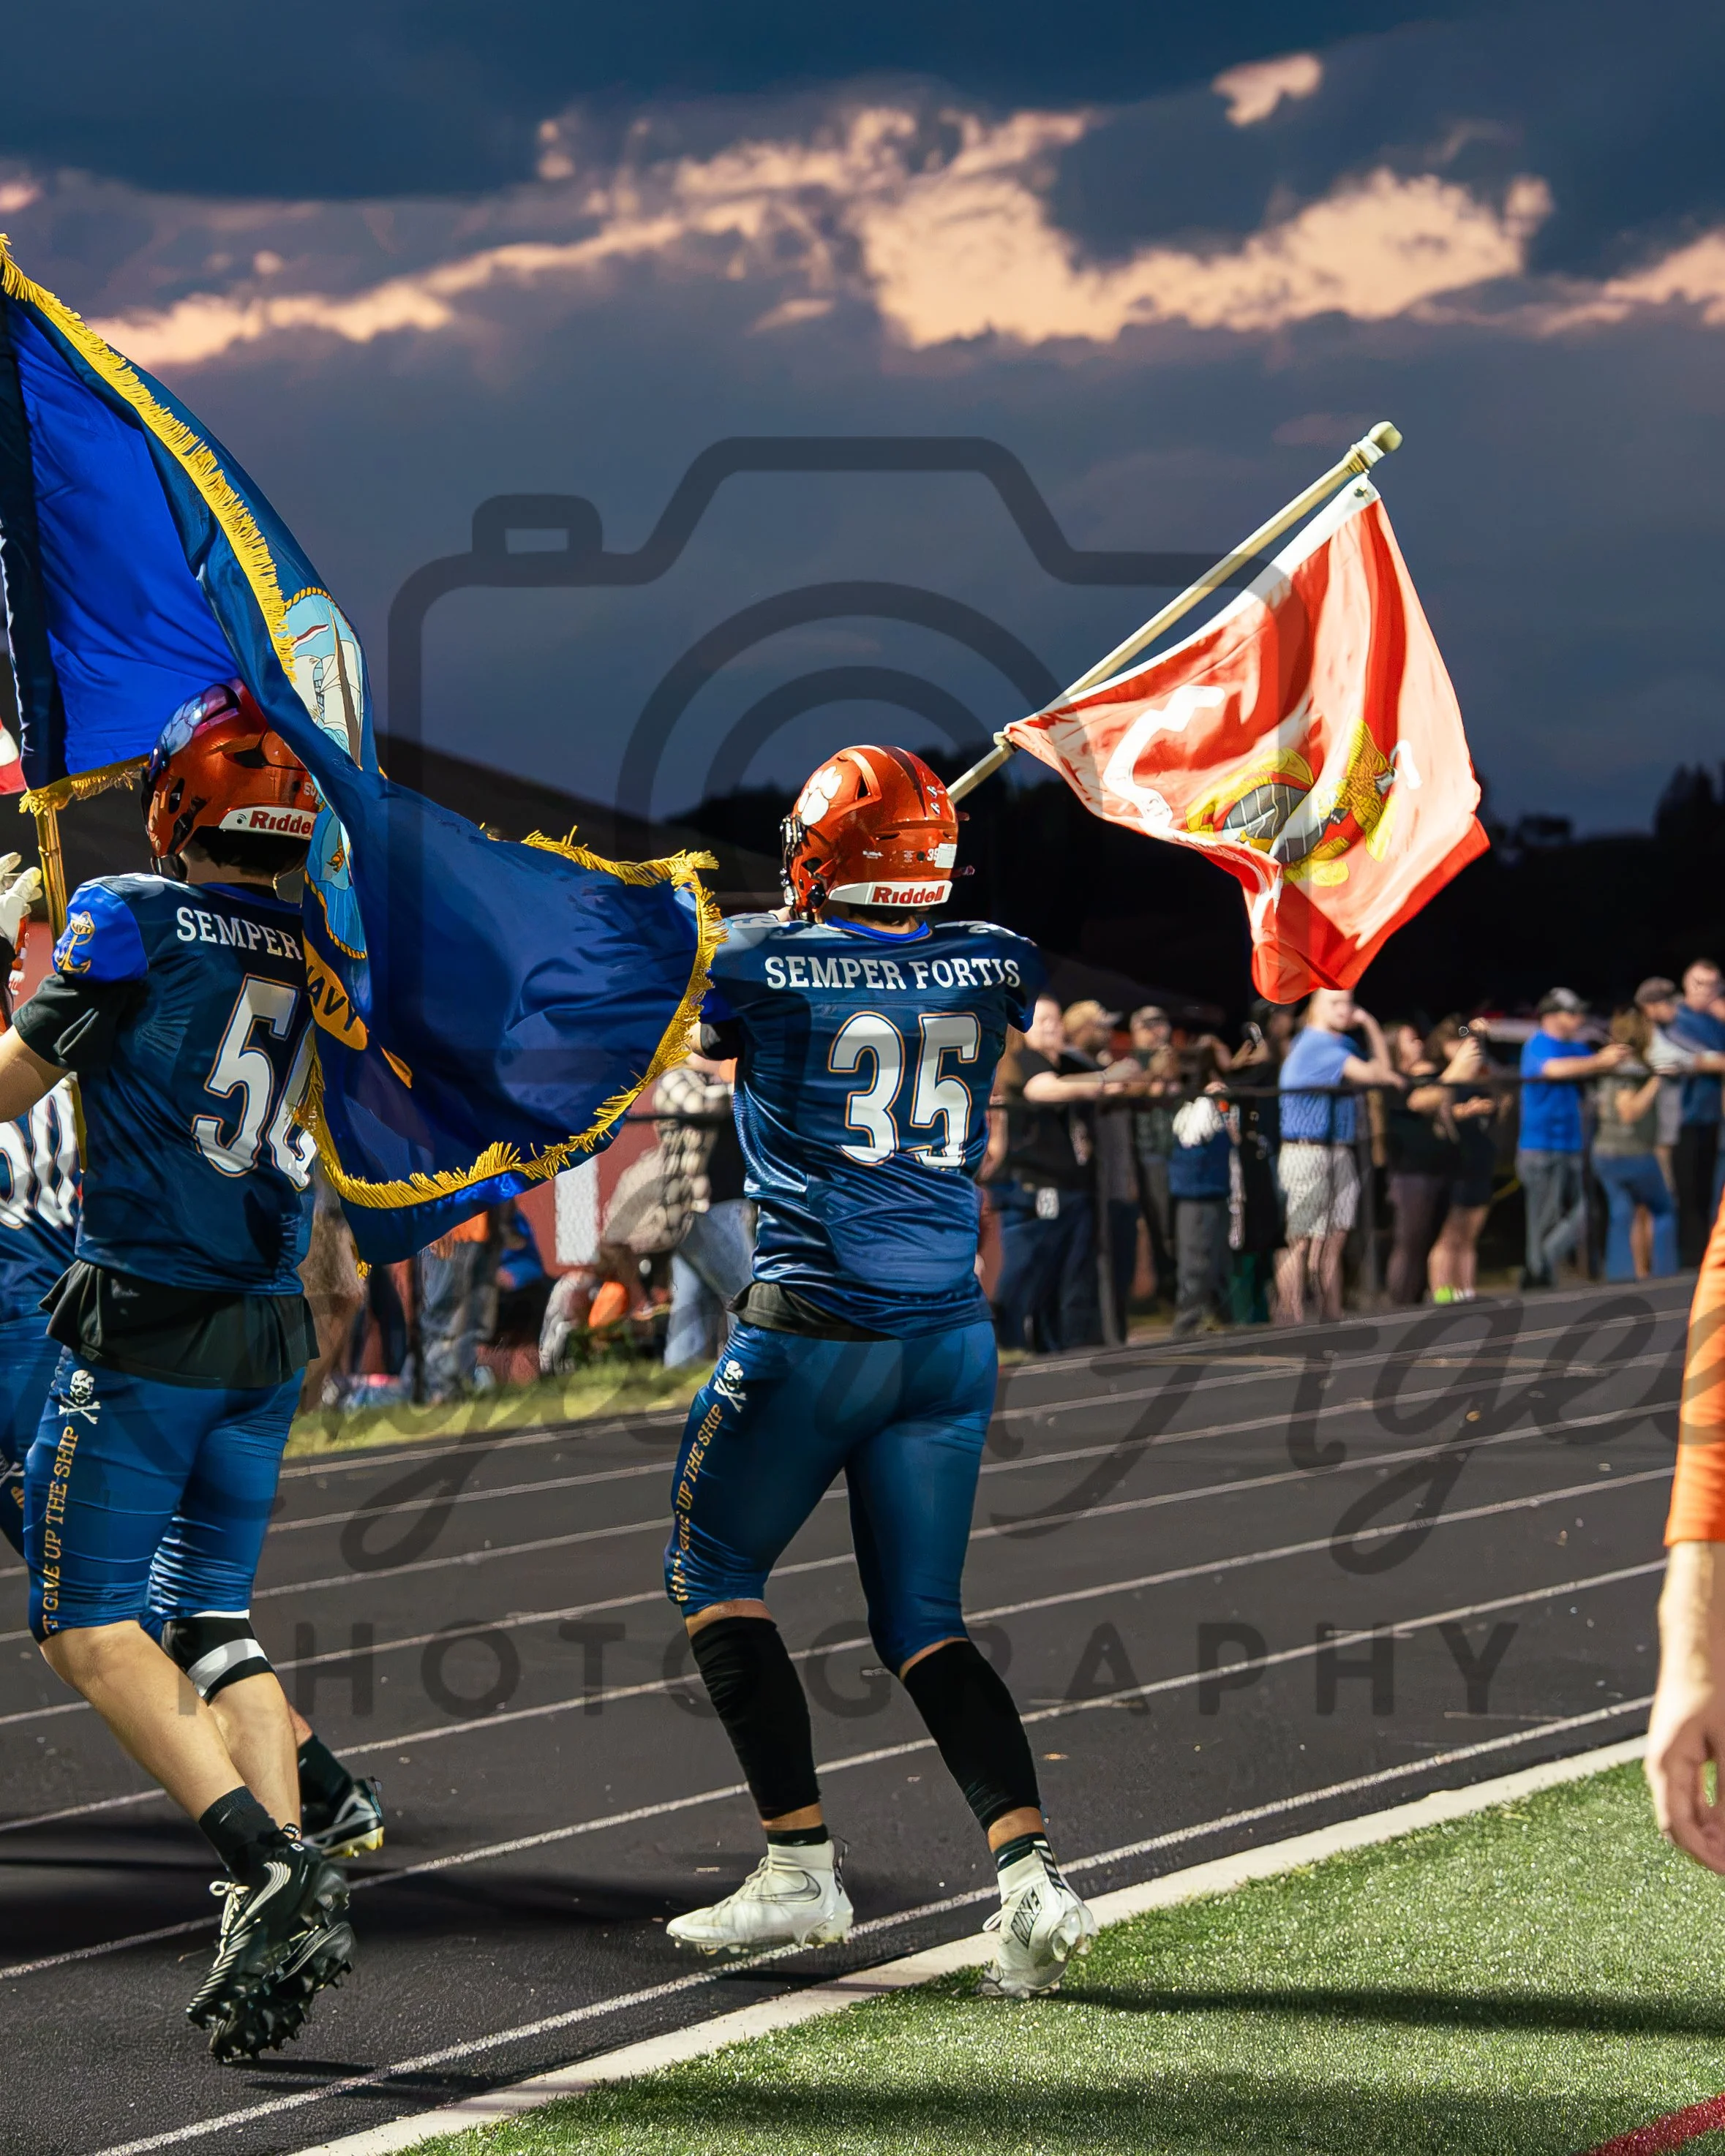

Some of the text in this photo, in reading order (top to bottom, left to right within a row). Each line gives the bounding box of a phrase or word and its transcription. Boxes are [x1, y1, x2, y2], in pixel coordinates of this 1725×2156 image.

[249, 810, 315, 836] Ridde
[176, 906, 303, 960] SEMPER
[764, 956, 1021, 990] SEMPER FORTIS
[301, 965, 357, 1032] AVY
[827, 1010, 982, 1170] 35
[697, 1403, 724, 1447] SHIP
[53, 1426, 79, 1478] SHIP
[683, 1441, 704, 1482] THE
[45, 1480, 68, 1525] THE
[676, 1480, 694, 1510] UP
[43, 1529, 61, 1560] UP
[42, 1564, 61, 1612] GIVE
